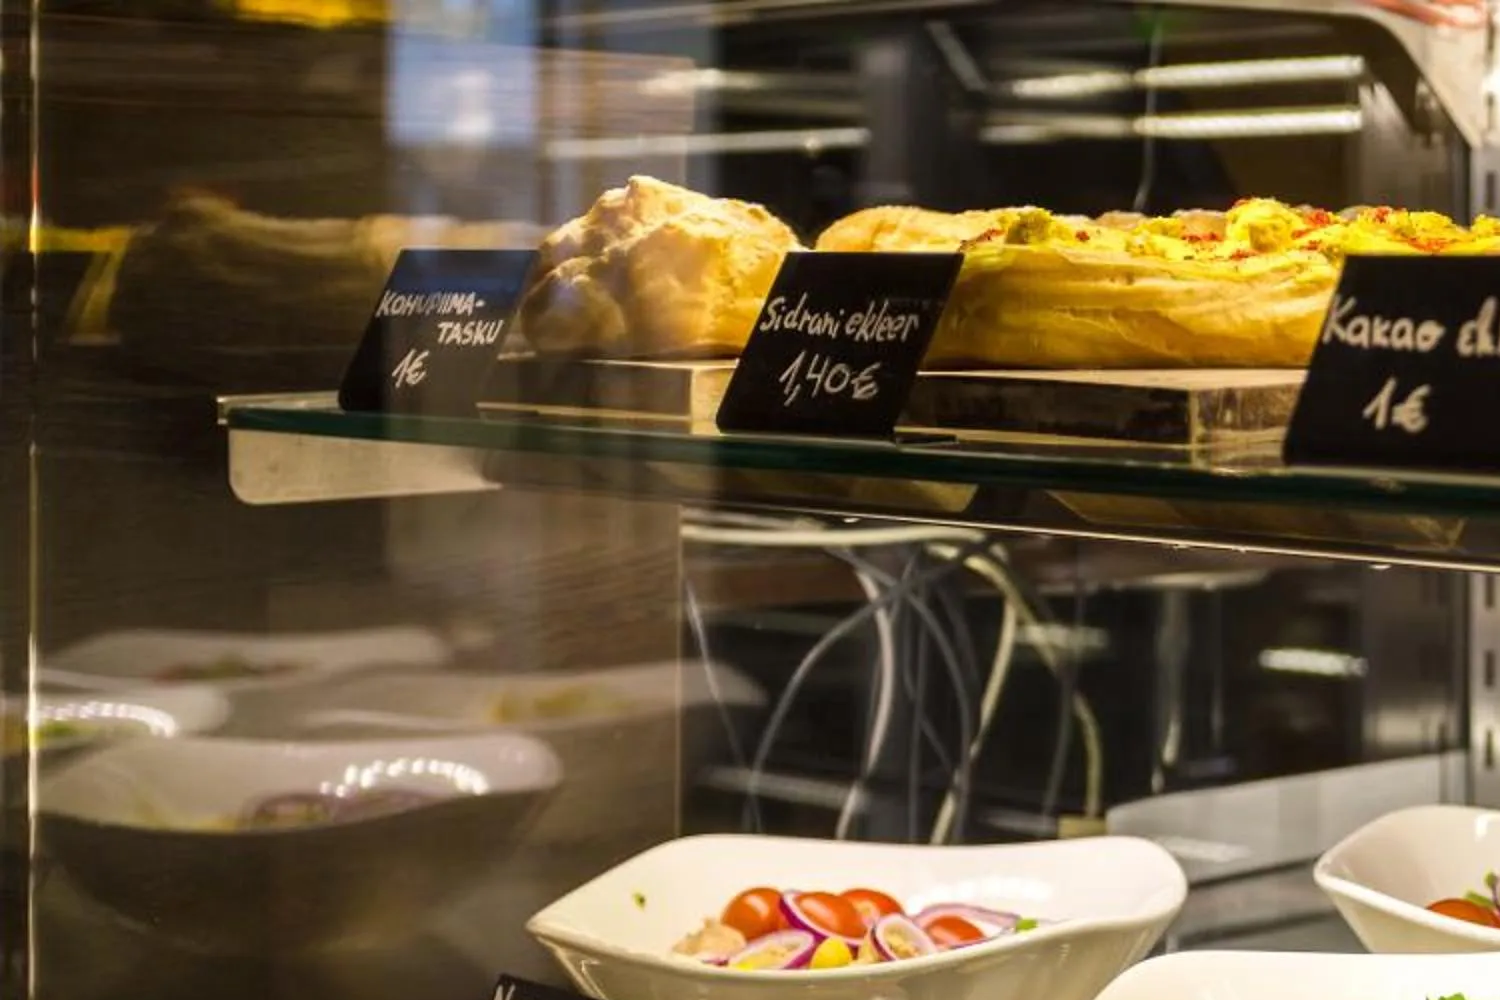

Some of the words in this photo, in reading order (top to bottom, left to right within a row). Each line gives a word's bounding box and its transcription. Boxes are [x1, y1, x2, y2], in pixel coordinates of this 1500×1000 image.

[375, 290, 486, 319] KOHUPIIMA-
[844, 299, 920, 343] ekleer
[1321, 295, 1447, 352] Kakao
[436, 319, 504, 345] TASKU
[391, 349, 431, 389] 1€
[778, 350, 881, 408] 1,40€
[1361, 376, 1432, 434] 1€
